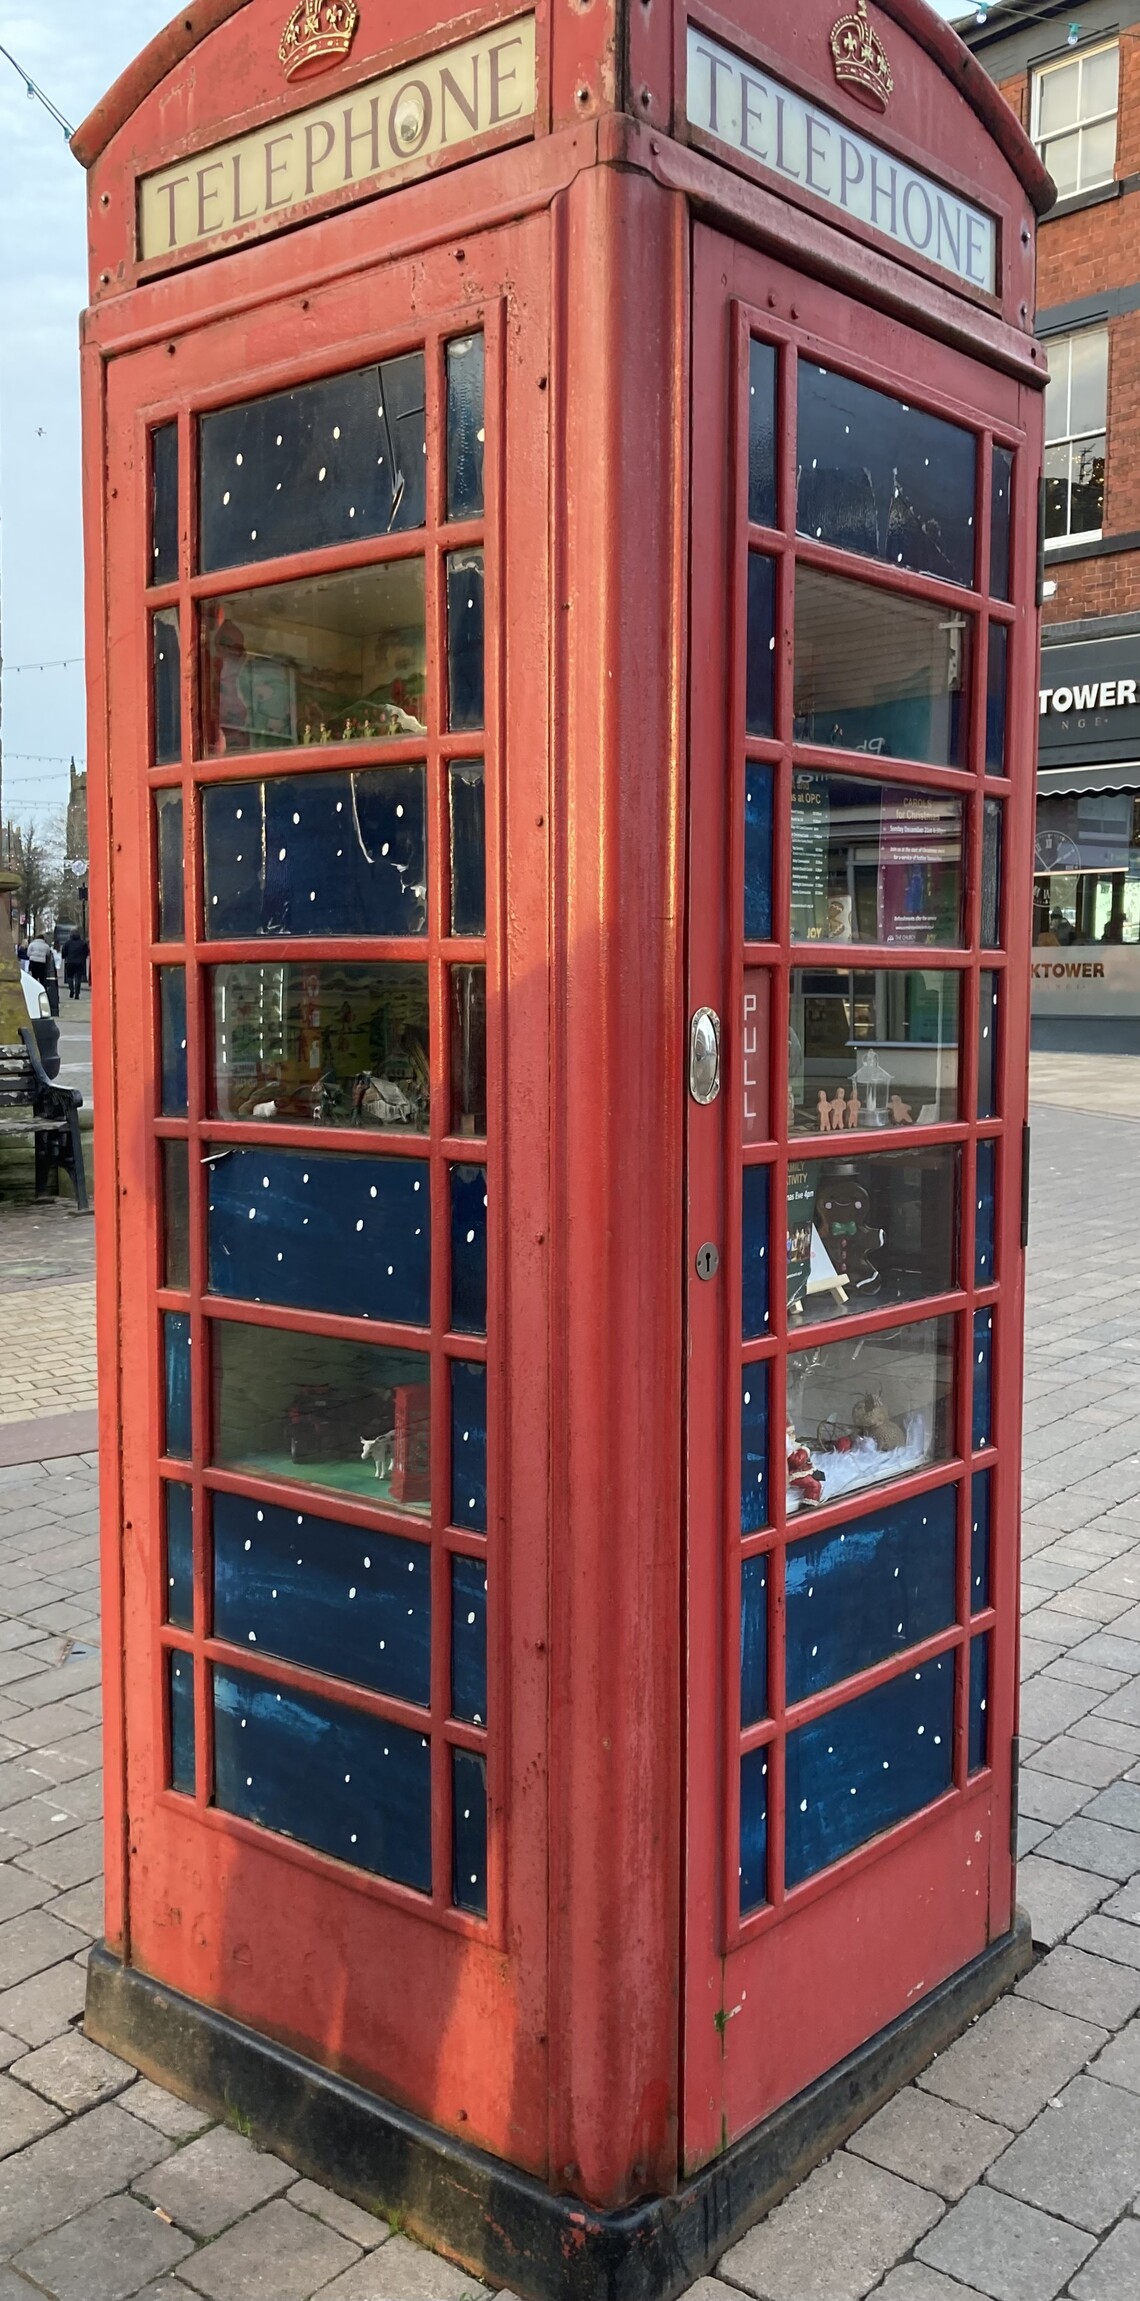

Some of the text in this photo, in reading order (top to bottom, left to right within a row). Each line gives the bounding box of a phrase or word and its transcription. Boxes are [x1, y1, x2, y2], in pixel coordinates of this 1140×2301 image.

[157, 36, 523, 247] TELEPHONE
[696, 46, 986, 285] TELEPHONE
[805, 793, 822, 804] OPC
[903, 797, 933, 809] CAROLS
[896, 809, 905, 820] for
[806, 927, 822, 939] JOY
[743, 994, 757, 1118] PULL
[795, 1191, 803, 1200] Eve
[804, 1190, 815, 1200] 4pm
